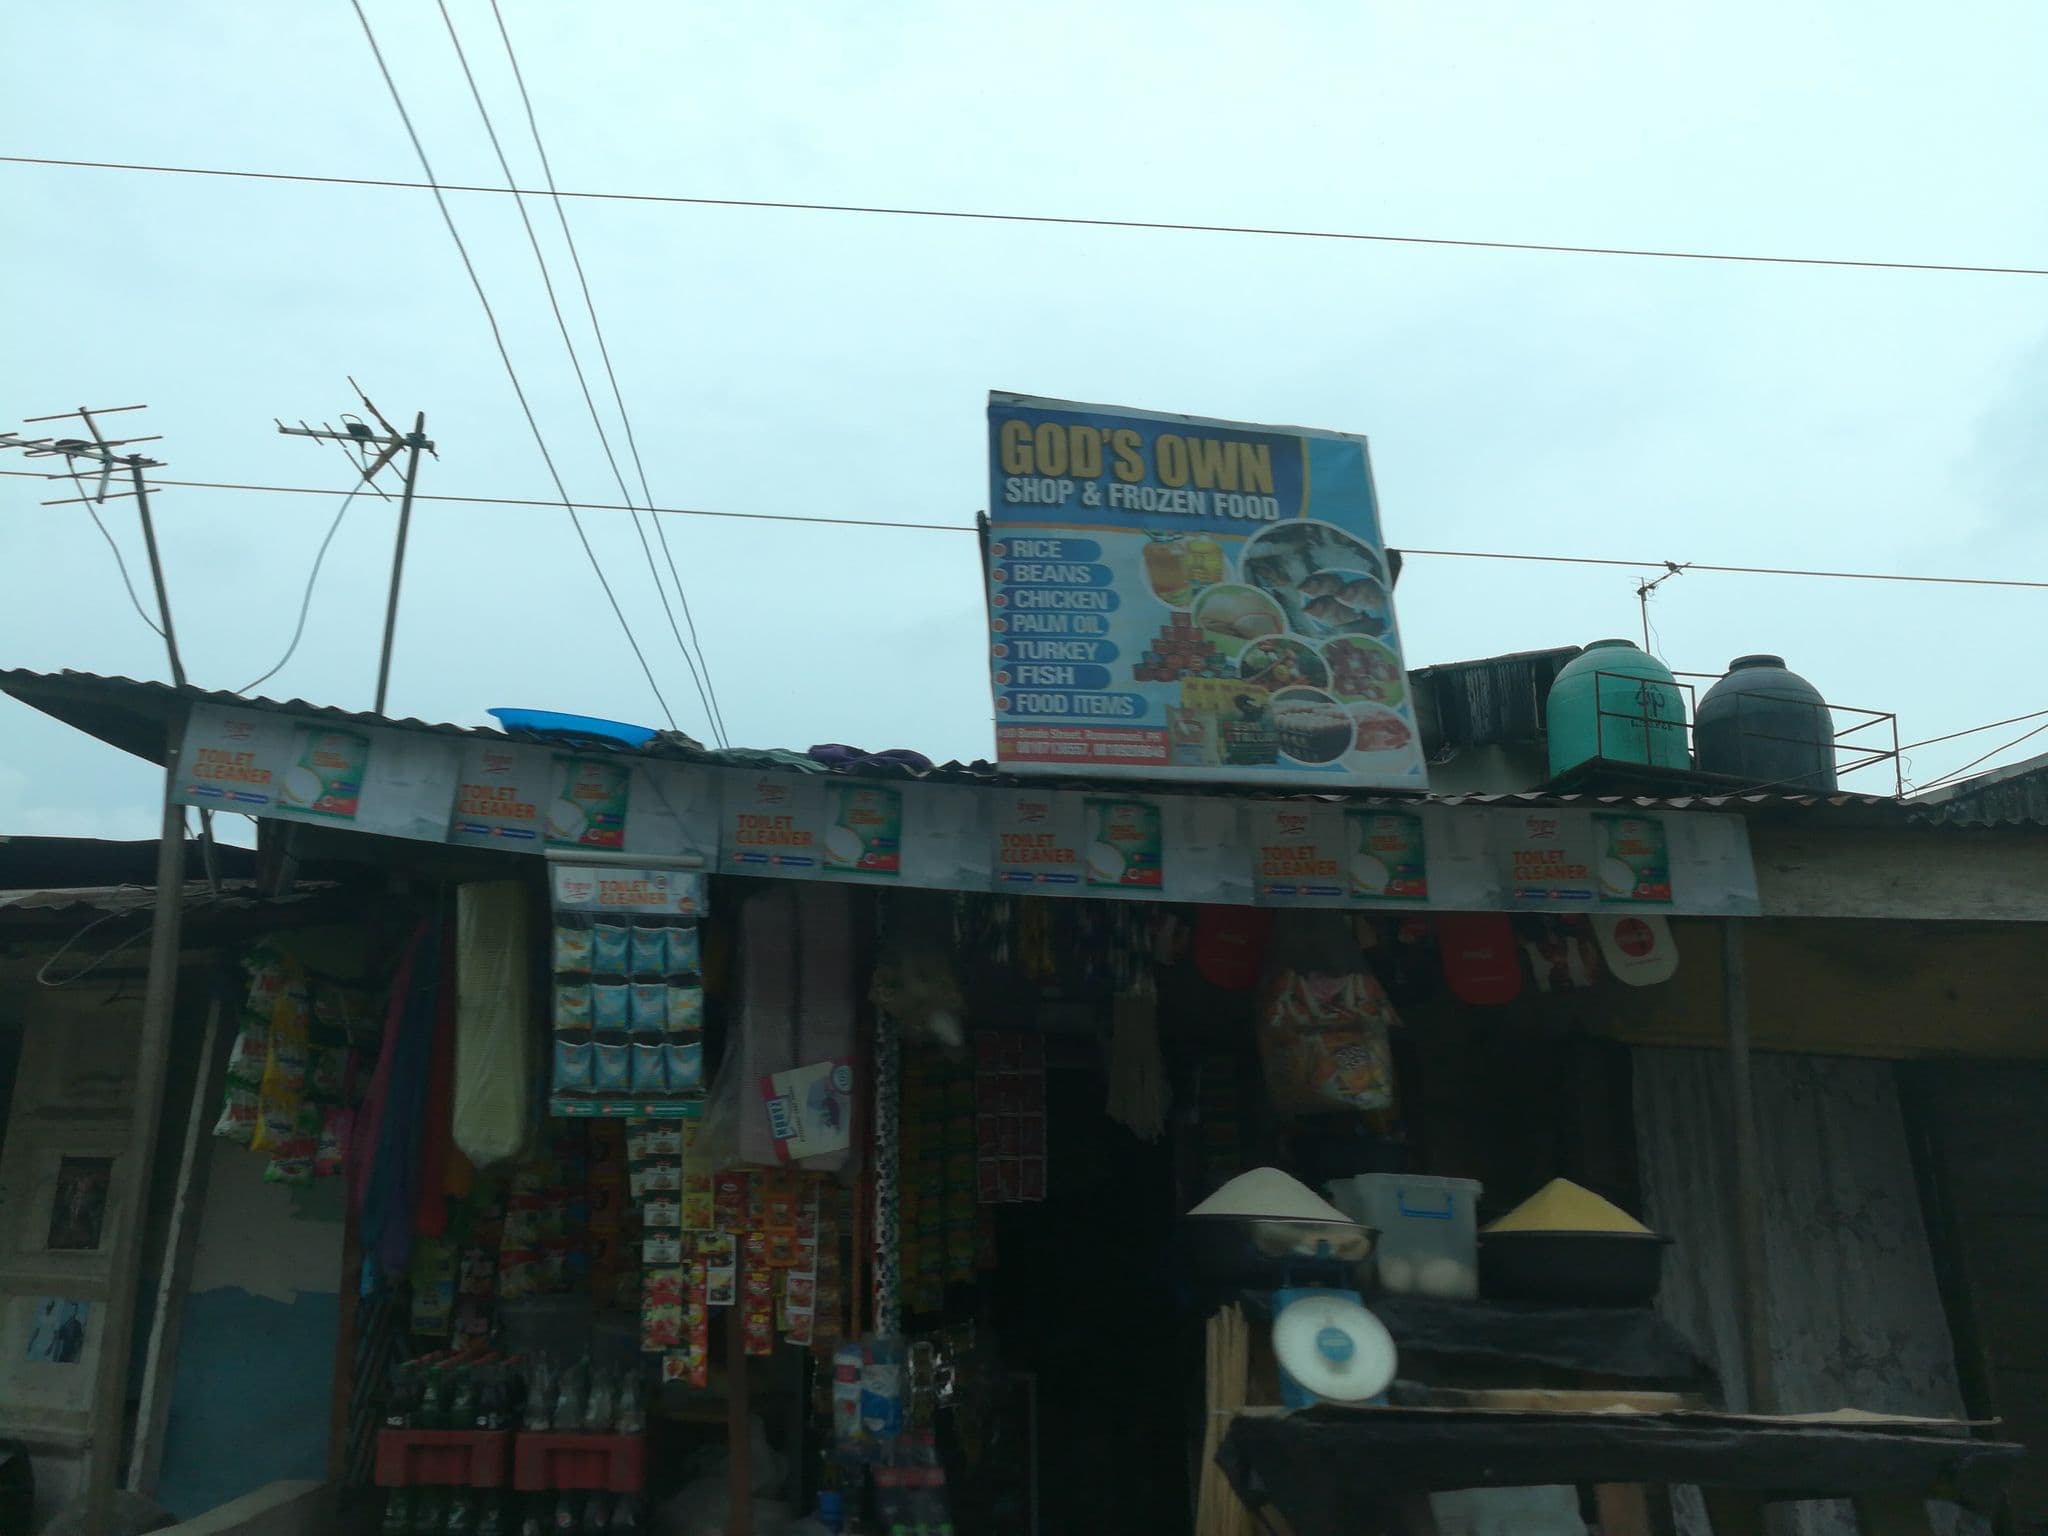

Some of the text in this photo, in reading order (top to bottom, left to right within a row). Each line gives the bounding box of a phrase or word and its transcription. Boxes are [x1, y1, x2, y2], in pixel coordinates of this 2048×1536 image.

[1001, 419, 1275, 494] GOD'S OWN
[1005, 478, 1280, 521] SHOP & FROZEN FOOD
[1012, 540, 1063, 558] RICE
[1013, 564, 1091, 583] BEANS
[1014, 590, 1109, 609] CHICKEN
[1012, 614, 1104, 634] PALM OIL
[1013, 641, 1099, 660] TURKEY
[1016, 666, 1076, 685] FISH
[1016, 694, 1135, 715] FOOD ITEMS
[198, 748, 256, 767] TOILET
[194, 763, 273, 784] CLEANER
[462, 784, 519, 801] TOILET
[458, 799, 537, 819] CLEANER
[737, 815, 794, 830] TOILET
[735, 829, 813, 846] CLEANER
[1000, 833, 1056, 848] TOILET
[1001, 848, 1076, 864] CLEANER
[1262, 846, 1315, 860] TOILET
[1512, 849, 1566, 865] TOILET
[1263, 860, 1338, 876] CLEANER
[1514, 864, 1587, 880] CLEANER
